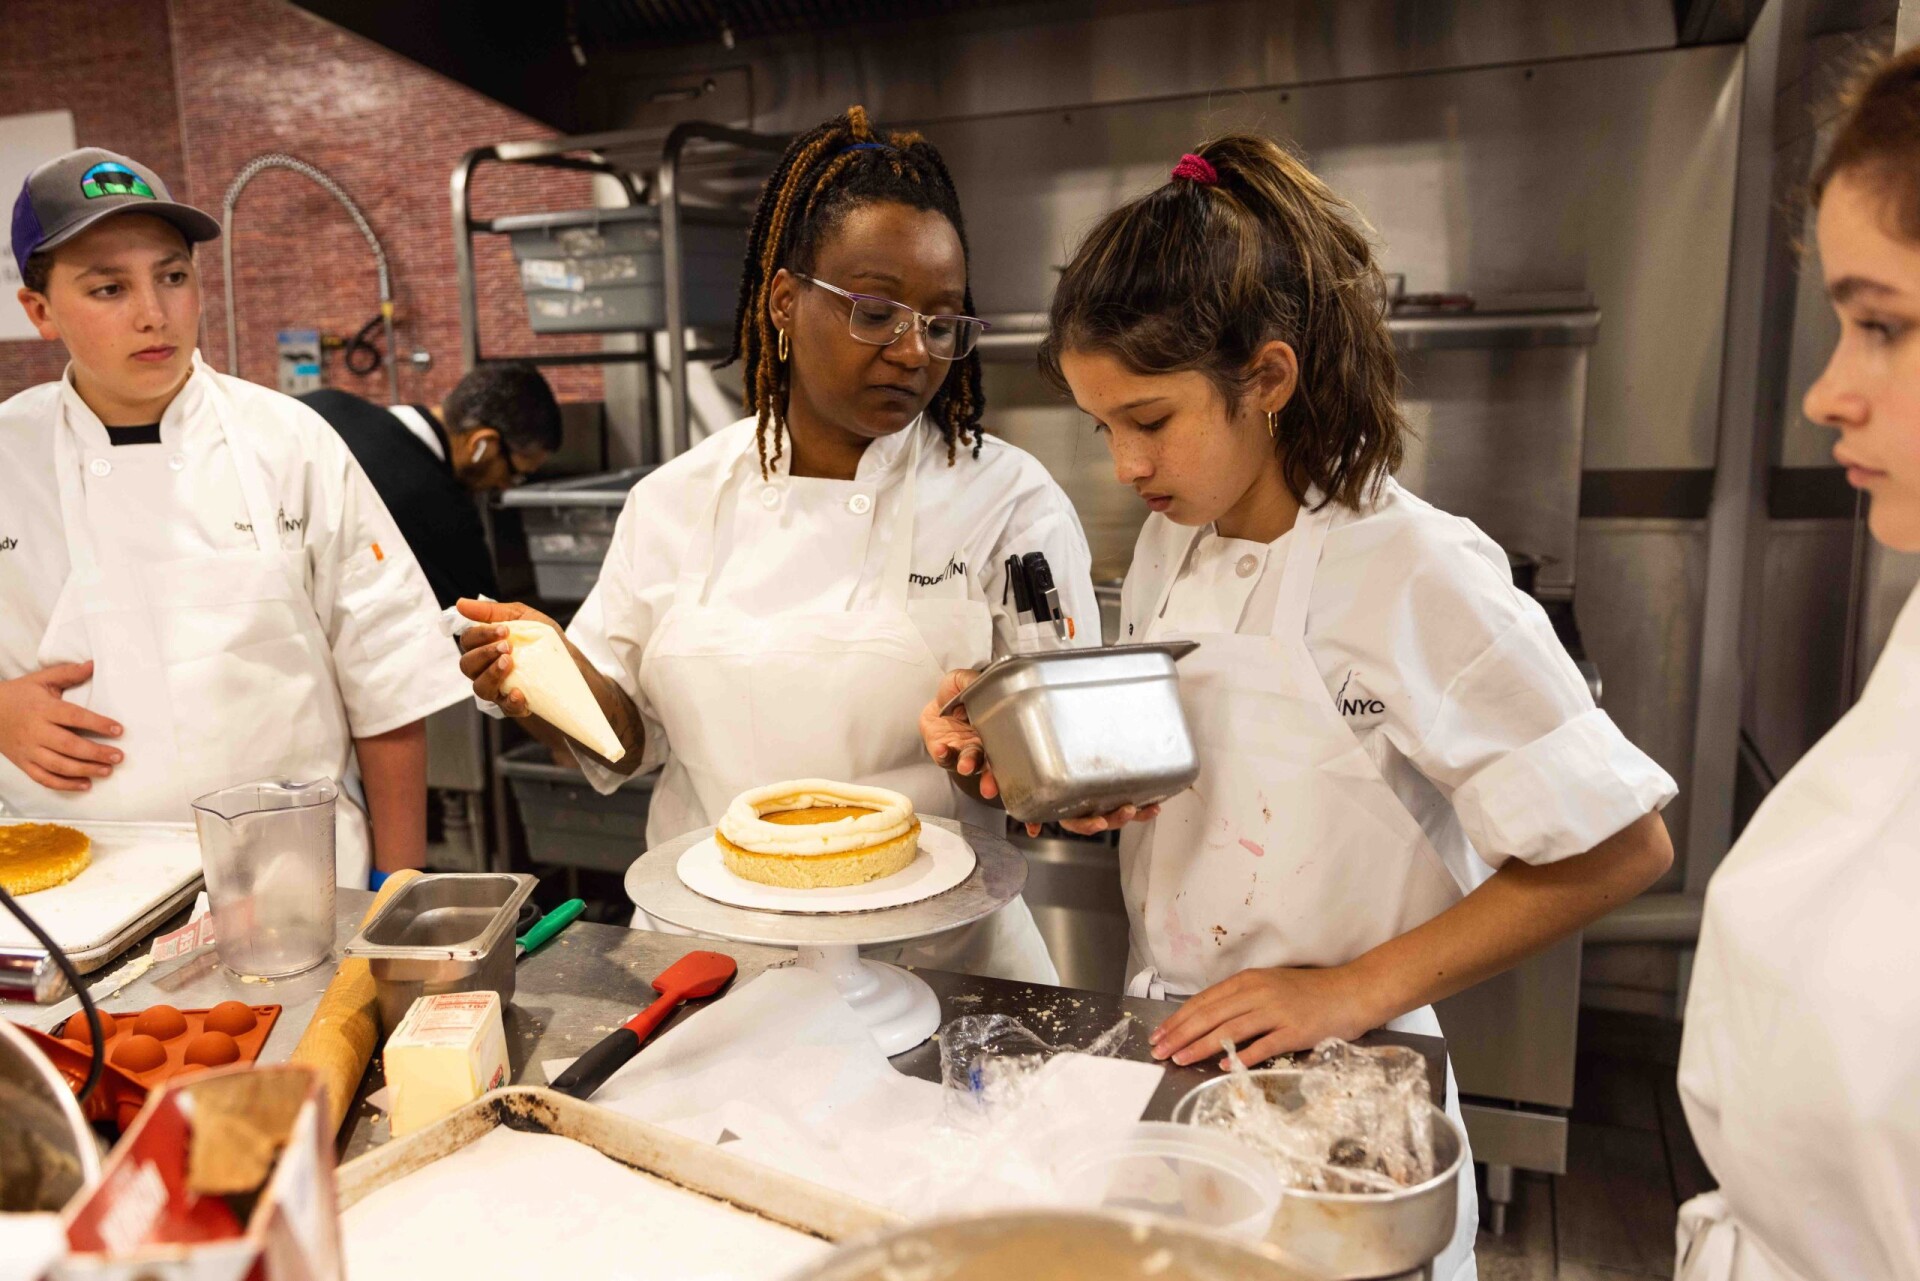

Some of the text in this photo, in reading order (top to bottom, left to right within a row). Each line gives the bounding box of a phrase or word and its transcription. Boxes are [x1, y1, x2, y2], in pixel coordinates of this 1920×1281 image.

[0, 536, 18, 551] dy
[908, 572, 944, 587] mpus
[1342, 699, 1385, 716] NYC
